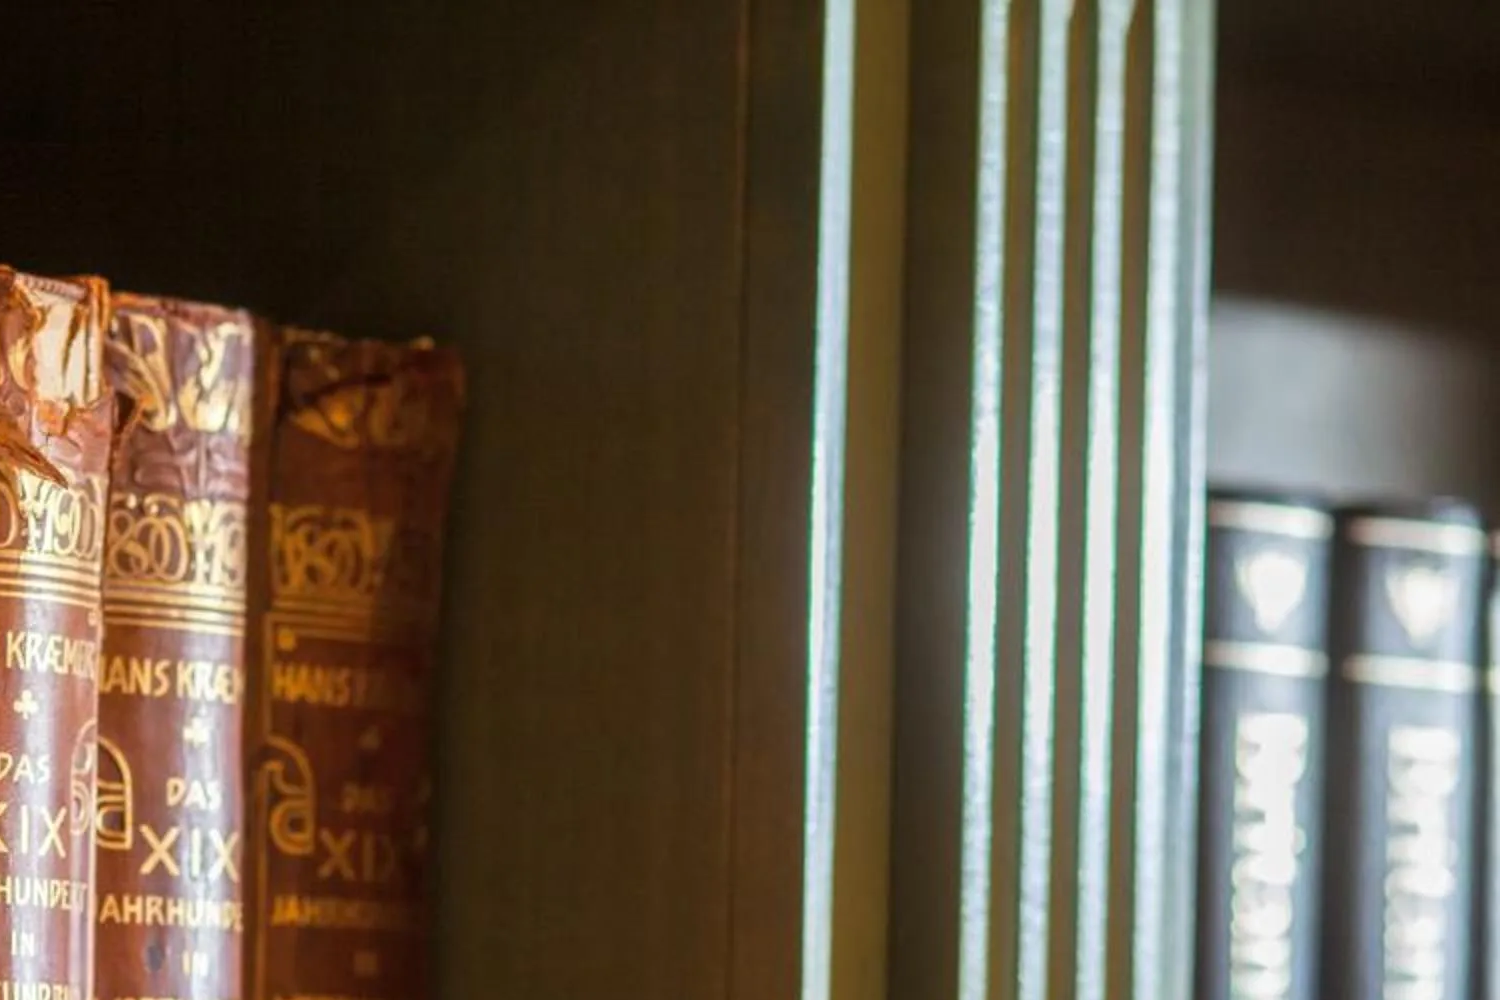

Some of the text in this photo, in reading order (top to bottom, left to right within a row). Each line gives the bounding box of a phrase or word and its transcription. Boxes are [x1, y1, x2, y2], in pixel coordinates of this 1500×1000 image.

[166, 777, 223, 812] DAS
[138, 824, 240, 884] XIX
[11, 929, 35, 957] IN
